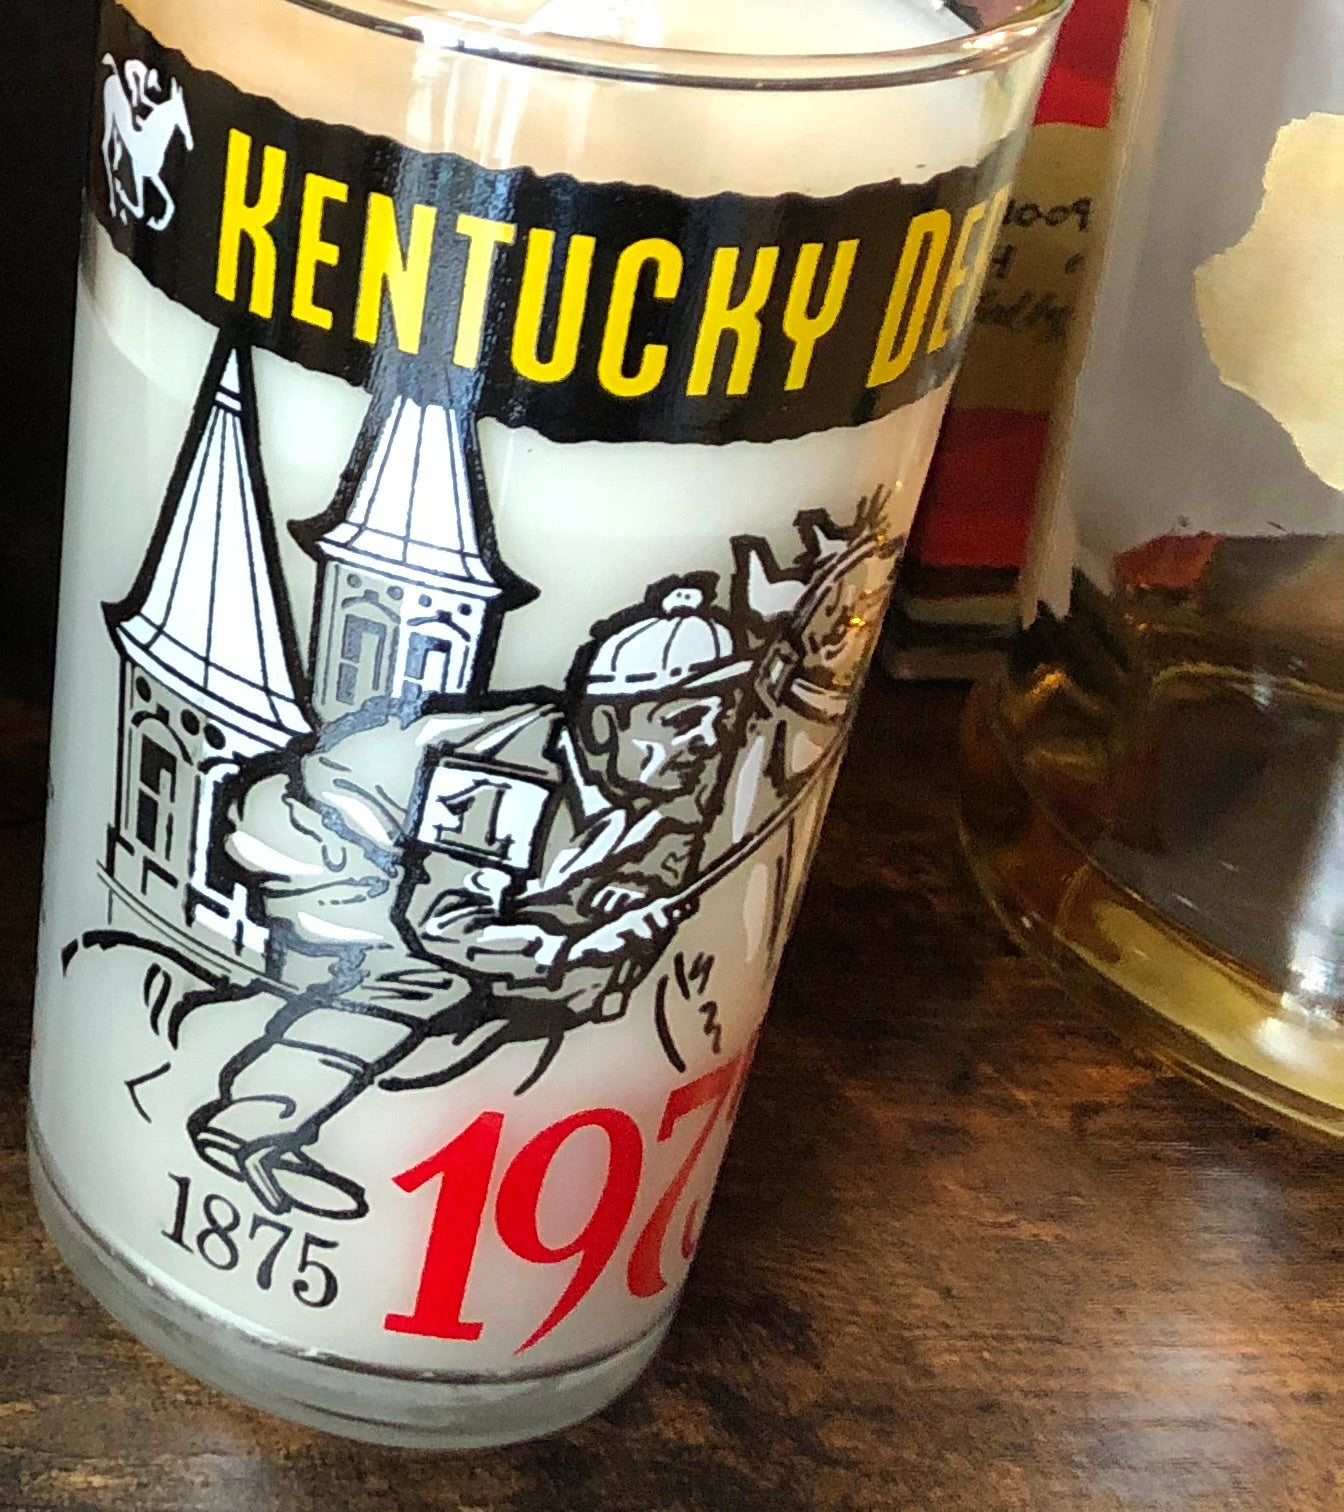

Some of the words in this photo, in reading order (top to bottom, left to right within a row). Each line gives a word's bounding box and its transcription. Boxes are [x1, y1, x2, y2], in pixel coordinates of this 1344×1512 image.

[214, 126, 861, 398] KENTUCKY
[434, 778, 516, 861] 1
[162, 1173, 341, 1309] 1875
